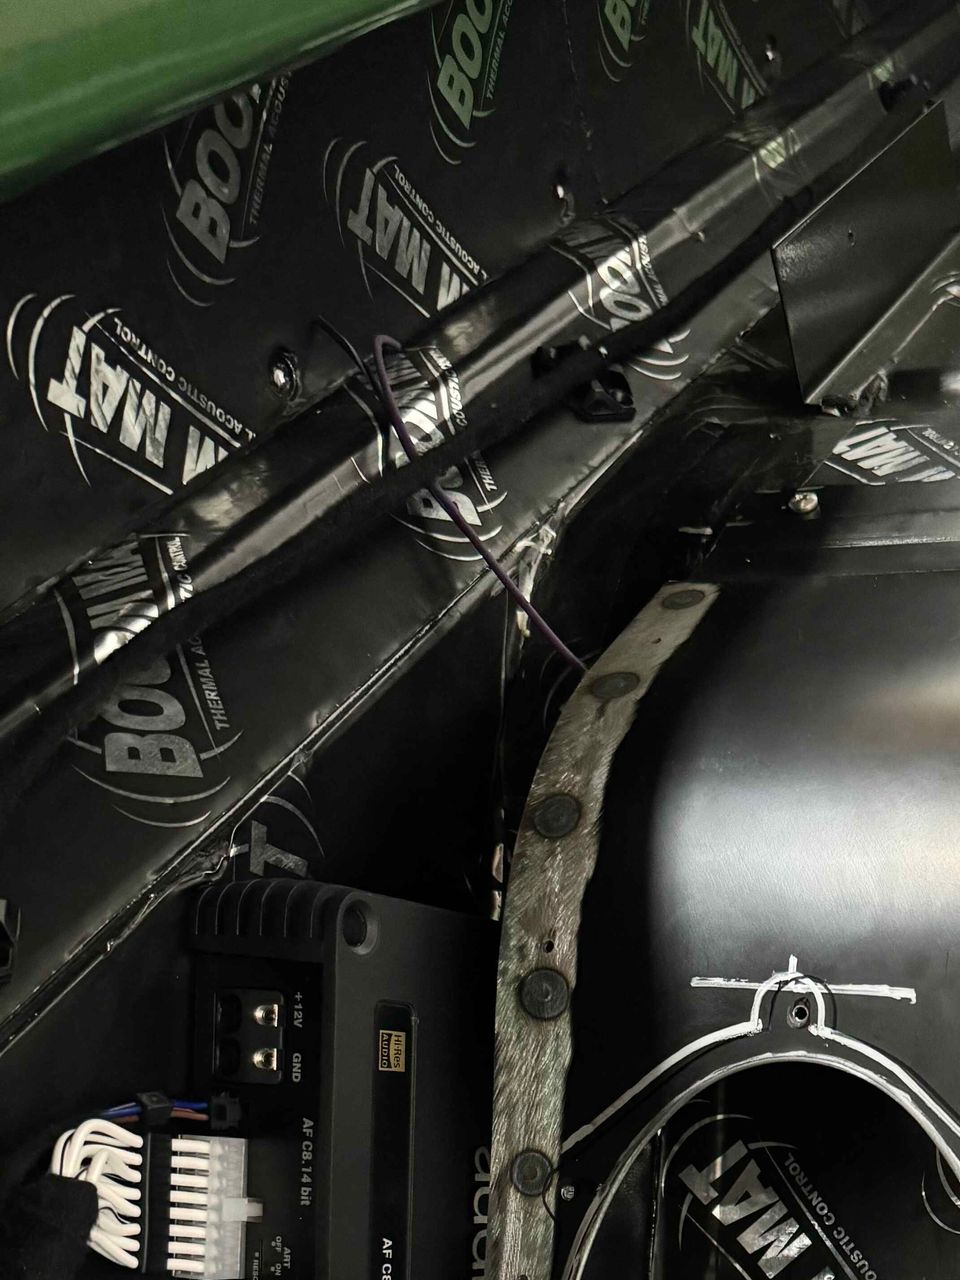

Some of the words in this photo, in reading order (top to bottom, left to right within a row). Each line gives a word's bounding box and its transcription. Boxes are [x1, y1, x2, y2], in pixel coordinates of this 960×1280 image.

[176, 83, 261, 264] BOO
[394, 163, 435, 225] CONTROL
[347, 167, 431, 295] MAT
[113, 317, 176, 380] CONTROL
[47, 325, 172, 469] MAT
[177, 379, 243, 435] ACOUSTIC
[194, 658, 230, 731] THERMAL
[293, 991, 303, 1029] +12V
[292, 1052, 302, 1083] GND
[381, 1033, 390, 1069] AUDIO
[302, 1117, 314, 1138] AF
[301, 1140, 314, 1184] C8.14
[300, 1186, 311, 1207] bit
[679, 1139, 813, 1279] MAT
[784, 1151, 841, 1239] CONTROL
[275, 1263, 282, 1276] ON
[283, 1246, 291, 1269] ART
[382, 1237, 393, 1259] AF
